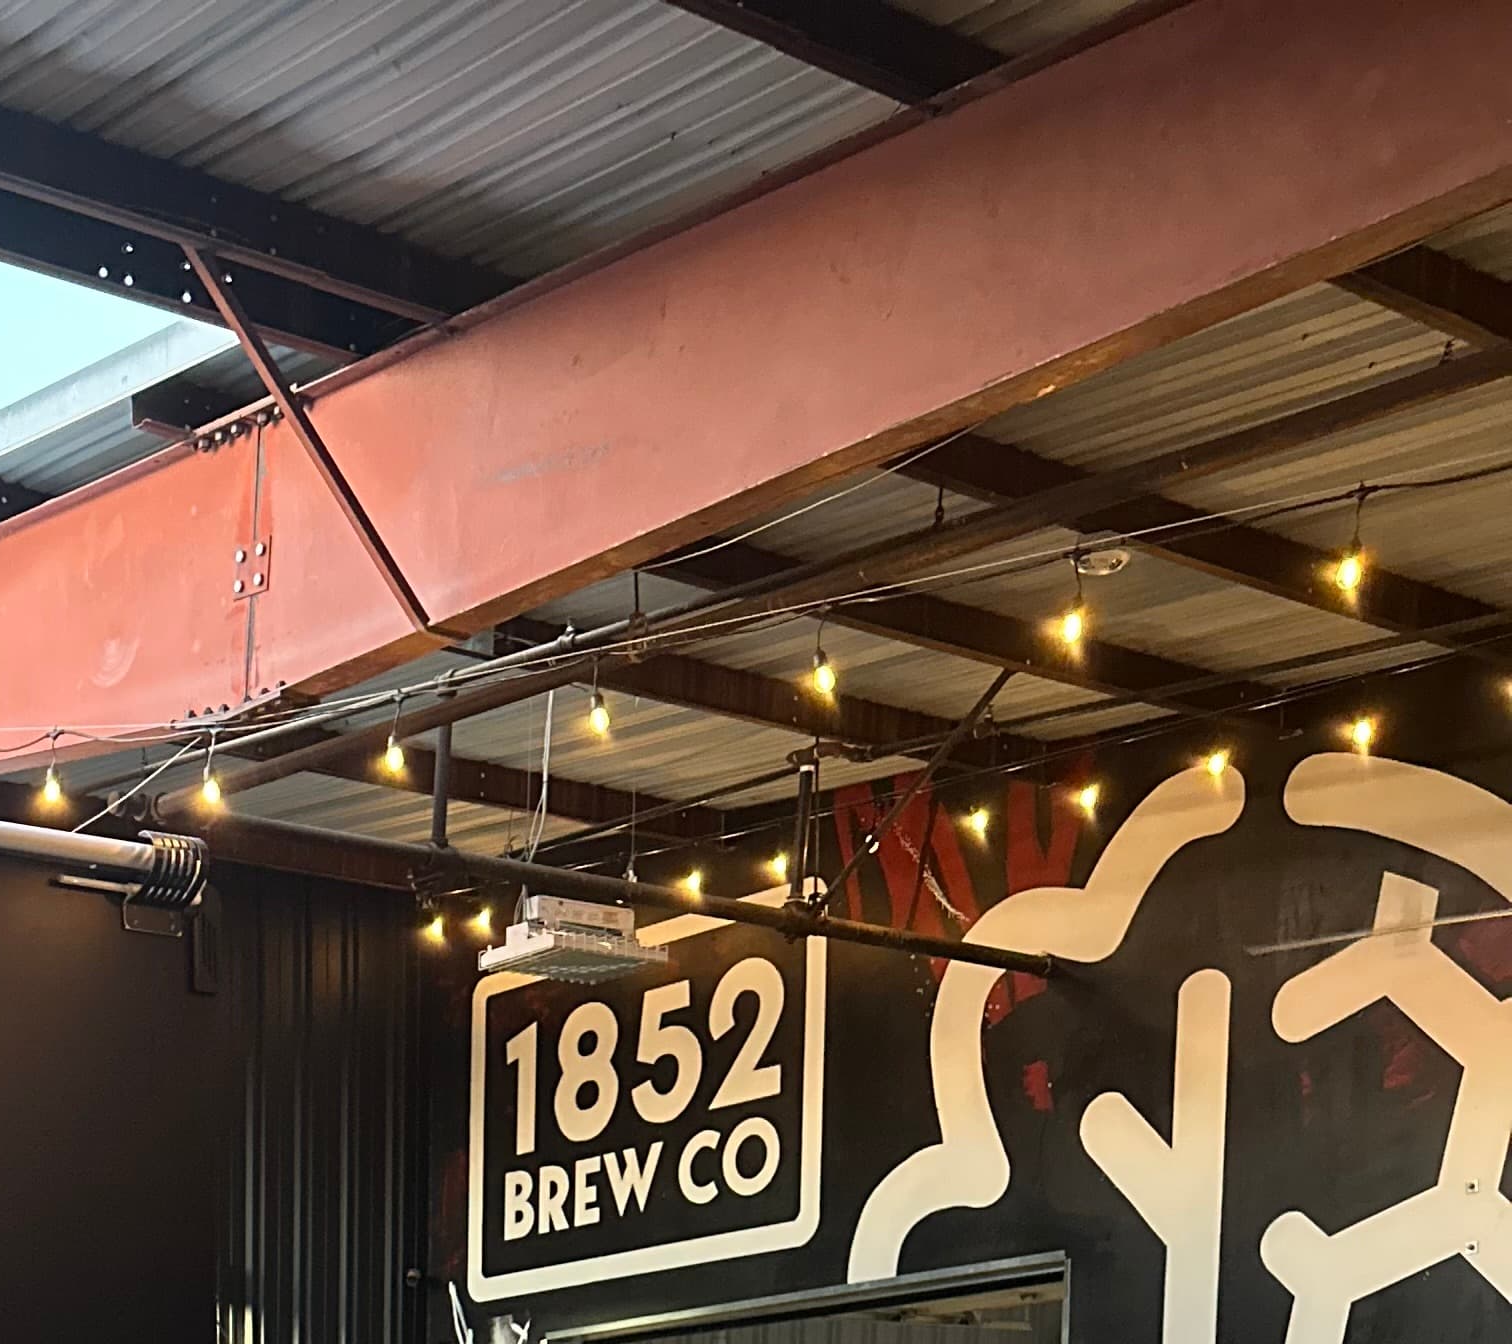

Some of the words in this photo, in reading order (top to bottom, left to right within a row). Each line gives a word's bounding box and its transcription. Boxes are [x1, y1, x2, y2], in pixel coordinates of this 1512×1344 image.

[505, 957, 785, 1156] 1852
[503, 1141, 663, 1241] BREW
[677, 1116, 781, 1204] CO
